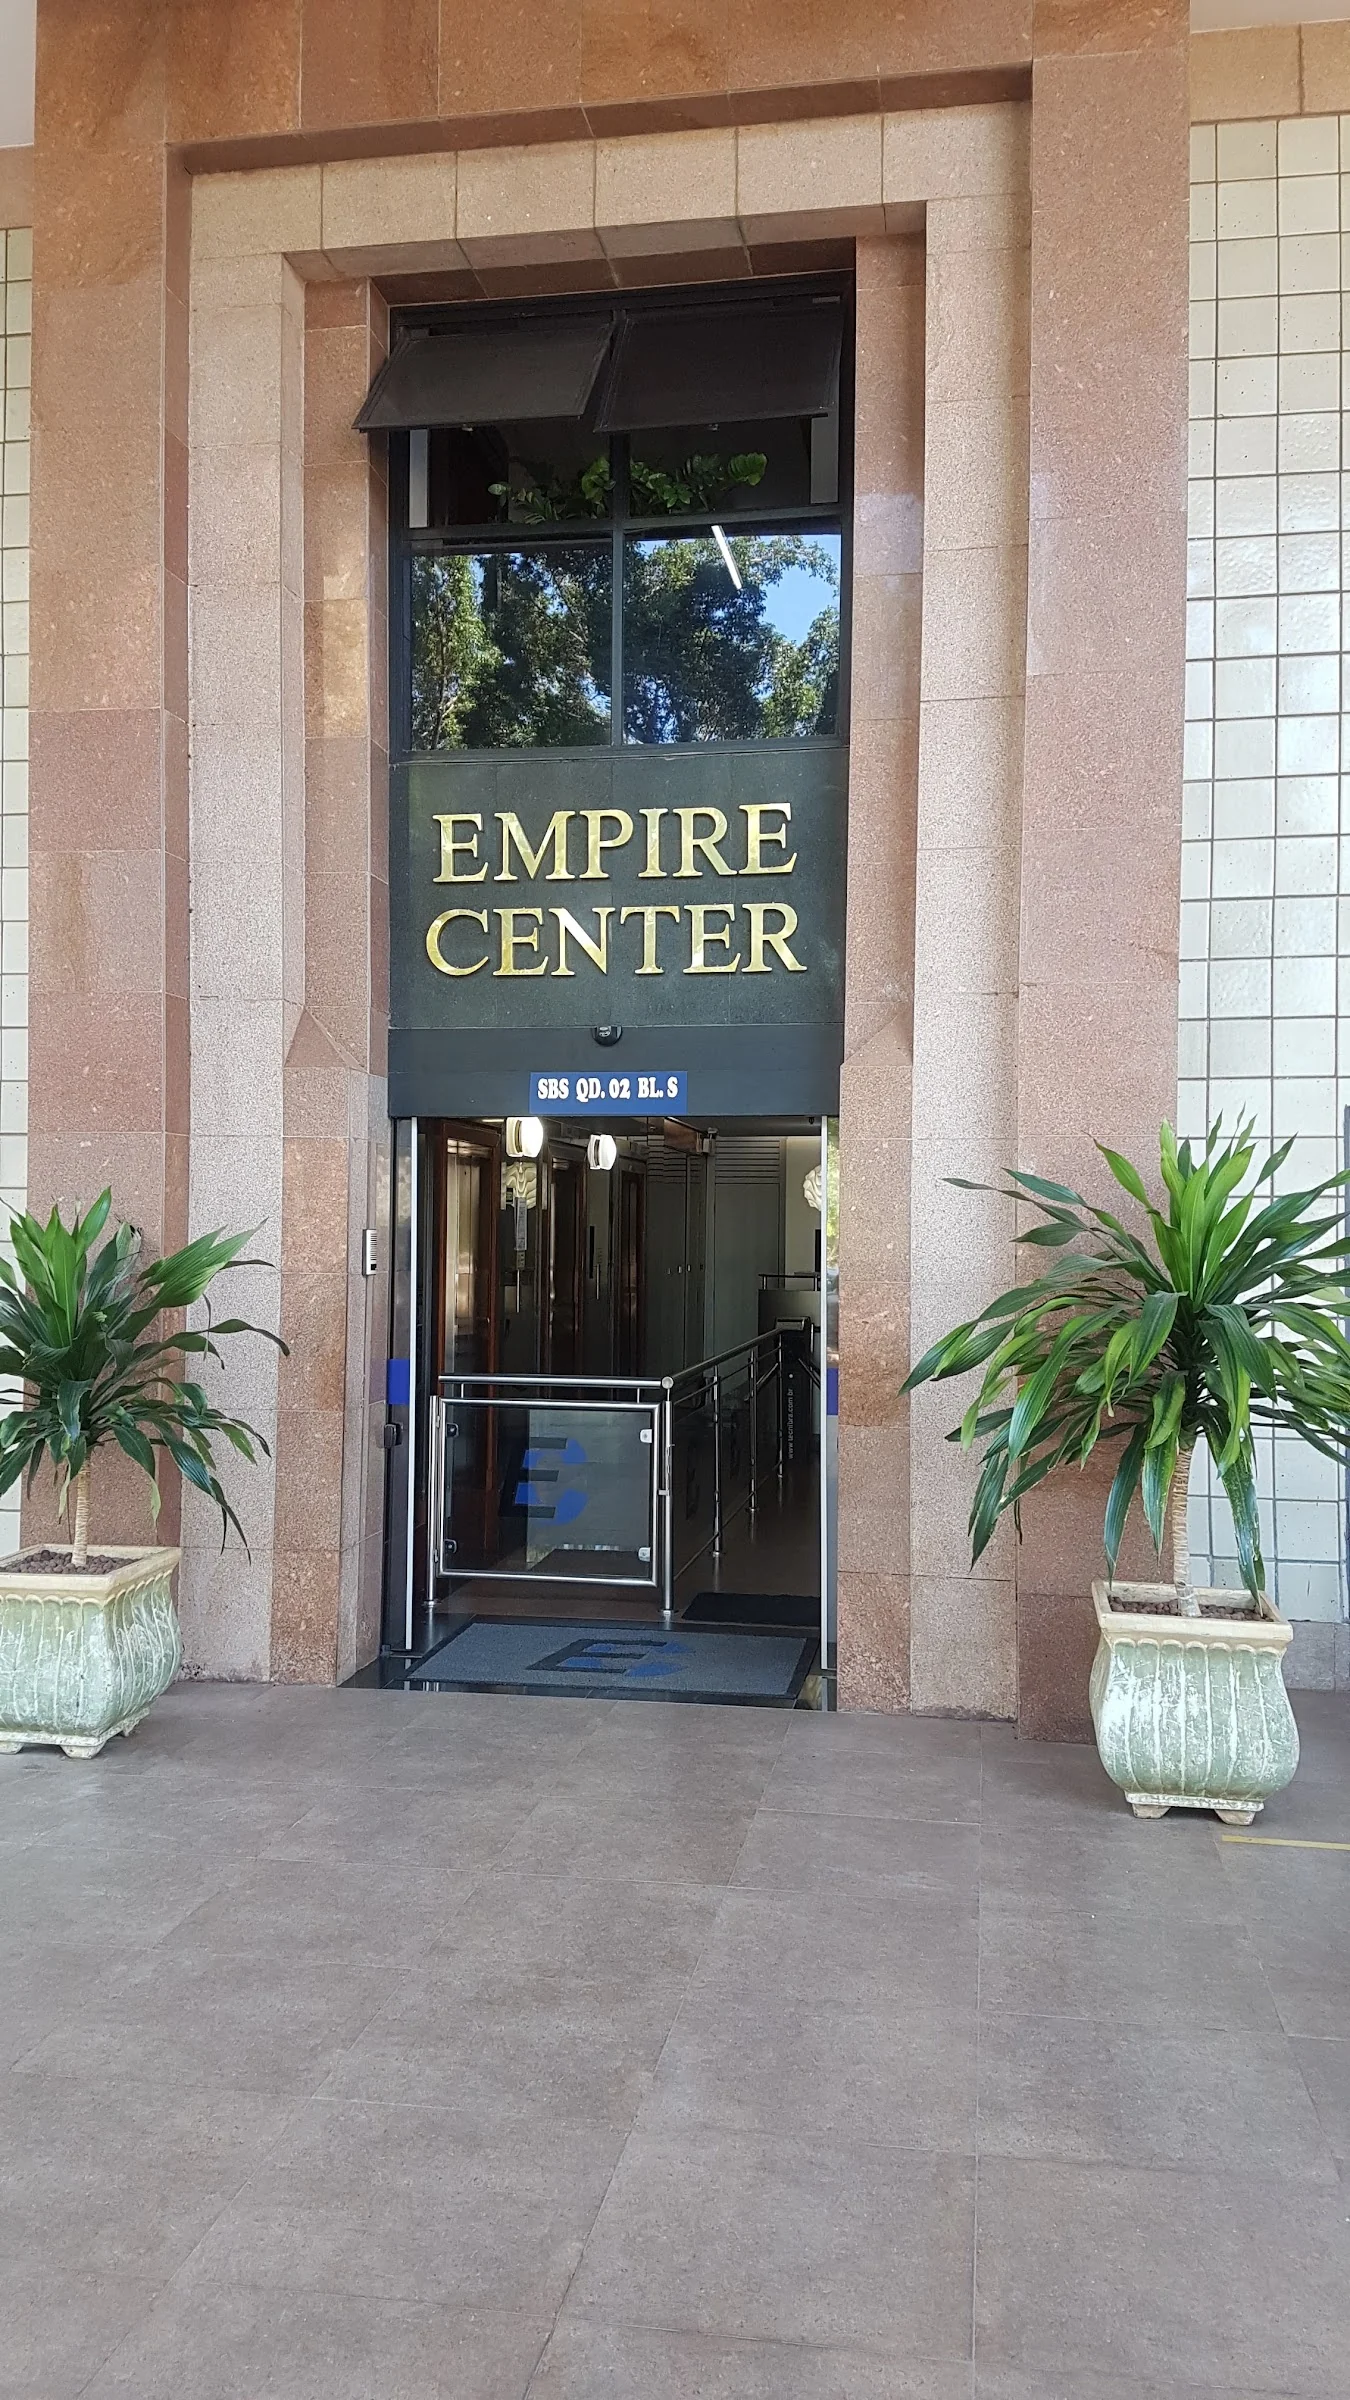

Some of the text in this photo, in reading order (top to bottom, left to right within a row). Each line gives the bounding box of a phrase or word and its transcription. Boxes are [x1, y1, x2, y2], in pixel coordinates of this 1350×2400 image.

[432, 802, 798, 883] EMPIRE
[425, 902, 808, 977] CENTER
[537, 1076, 679, 1103] SBS QD. 02 BL. S
[786, 1388, 794, 1460] wwwtecnibra.combr
